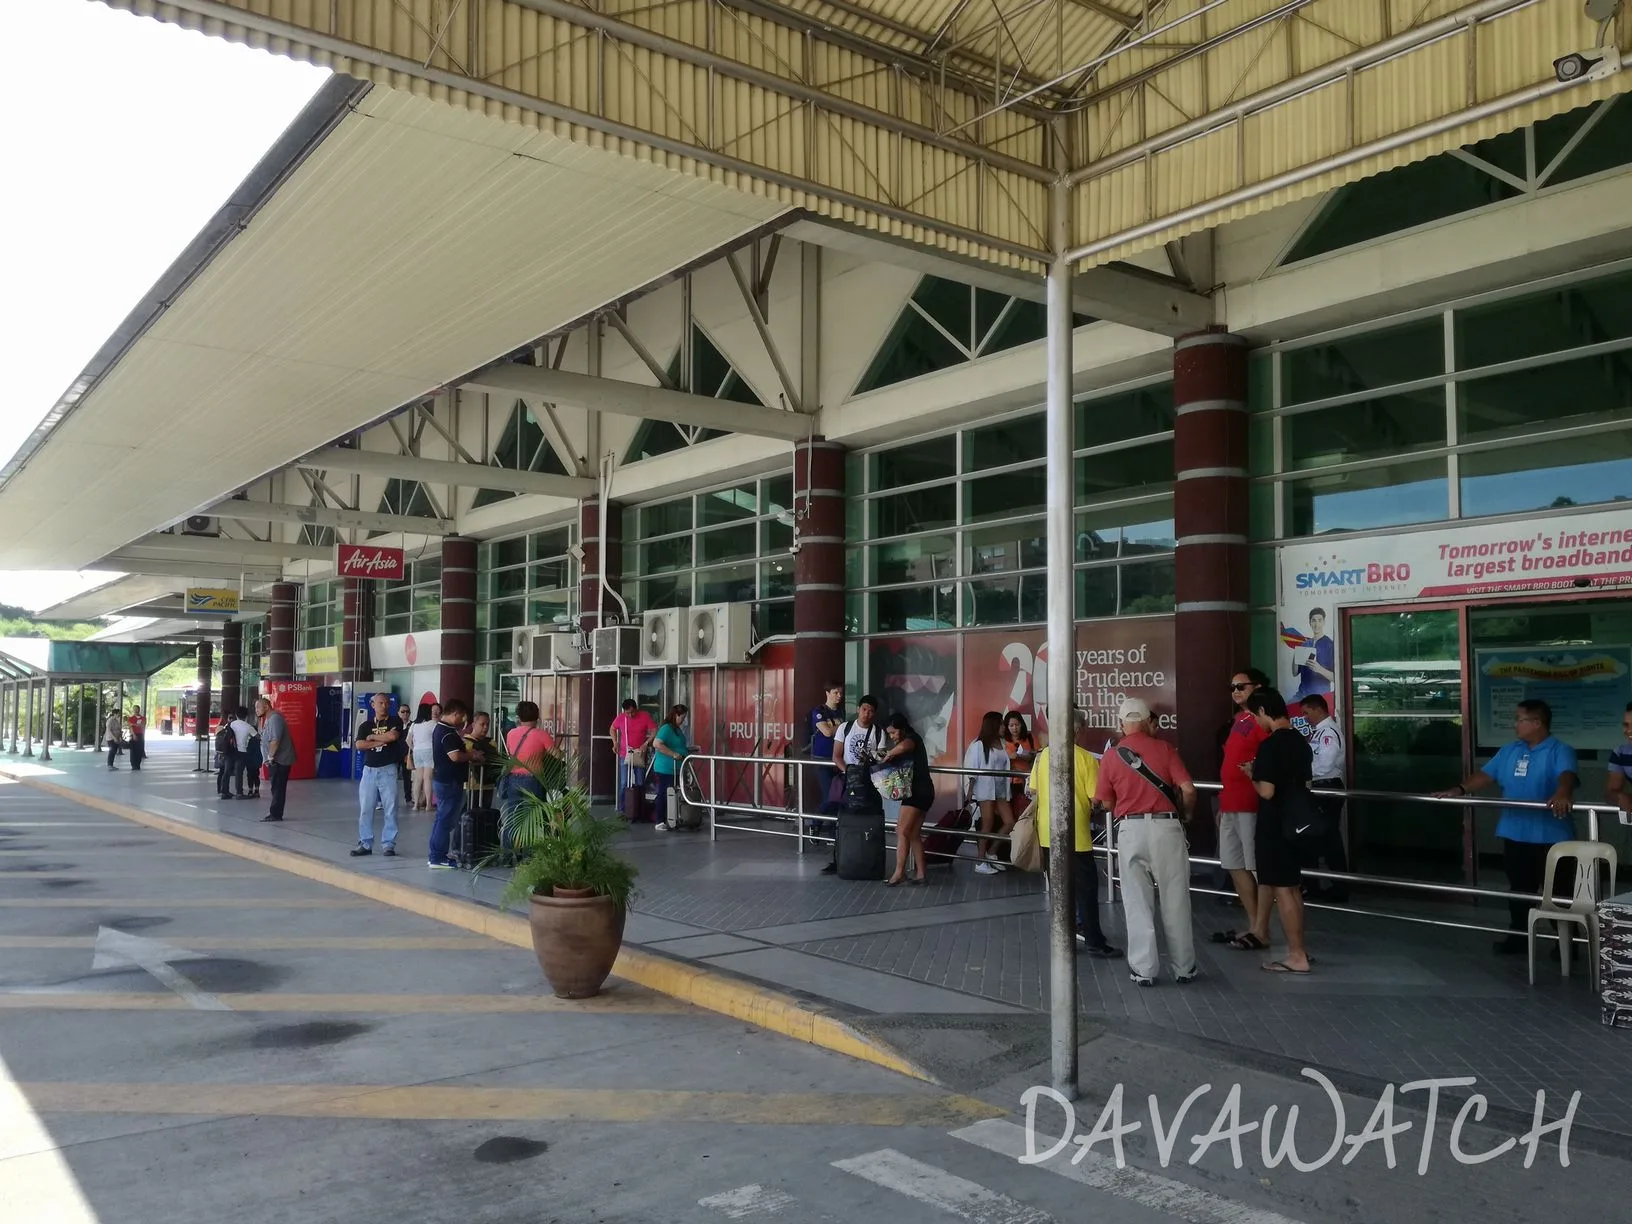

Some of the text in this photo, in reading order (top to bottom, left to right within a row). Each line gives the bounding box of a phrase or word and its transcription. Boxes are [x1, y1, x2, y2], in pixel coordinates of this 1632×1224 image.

[1438, 533, 1553, 560] Tomorrow's
[344, 549, 398, 574] AirAsia
[1447, 544, 1632, 579] largest broadband
[1300, 583, 1408, 597] TOMORROW'S INTERNET
[1487, 584, 1502, 592] THE
[1504, 582, 1532, 592] SMART
[1533, 580, 1550, 590] BRO
[1551, 579, 1576, 589] BOOT
[1600, 576, 1618, 586] THE
[1076, 644, 1147, 669] years of
[287, 683, 313, 692] PSBank
[1076, 668, 1165, 688] Prudence
[1076, 688, 1127, 708] in the
[729, 722, 753, 739] PRU
